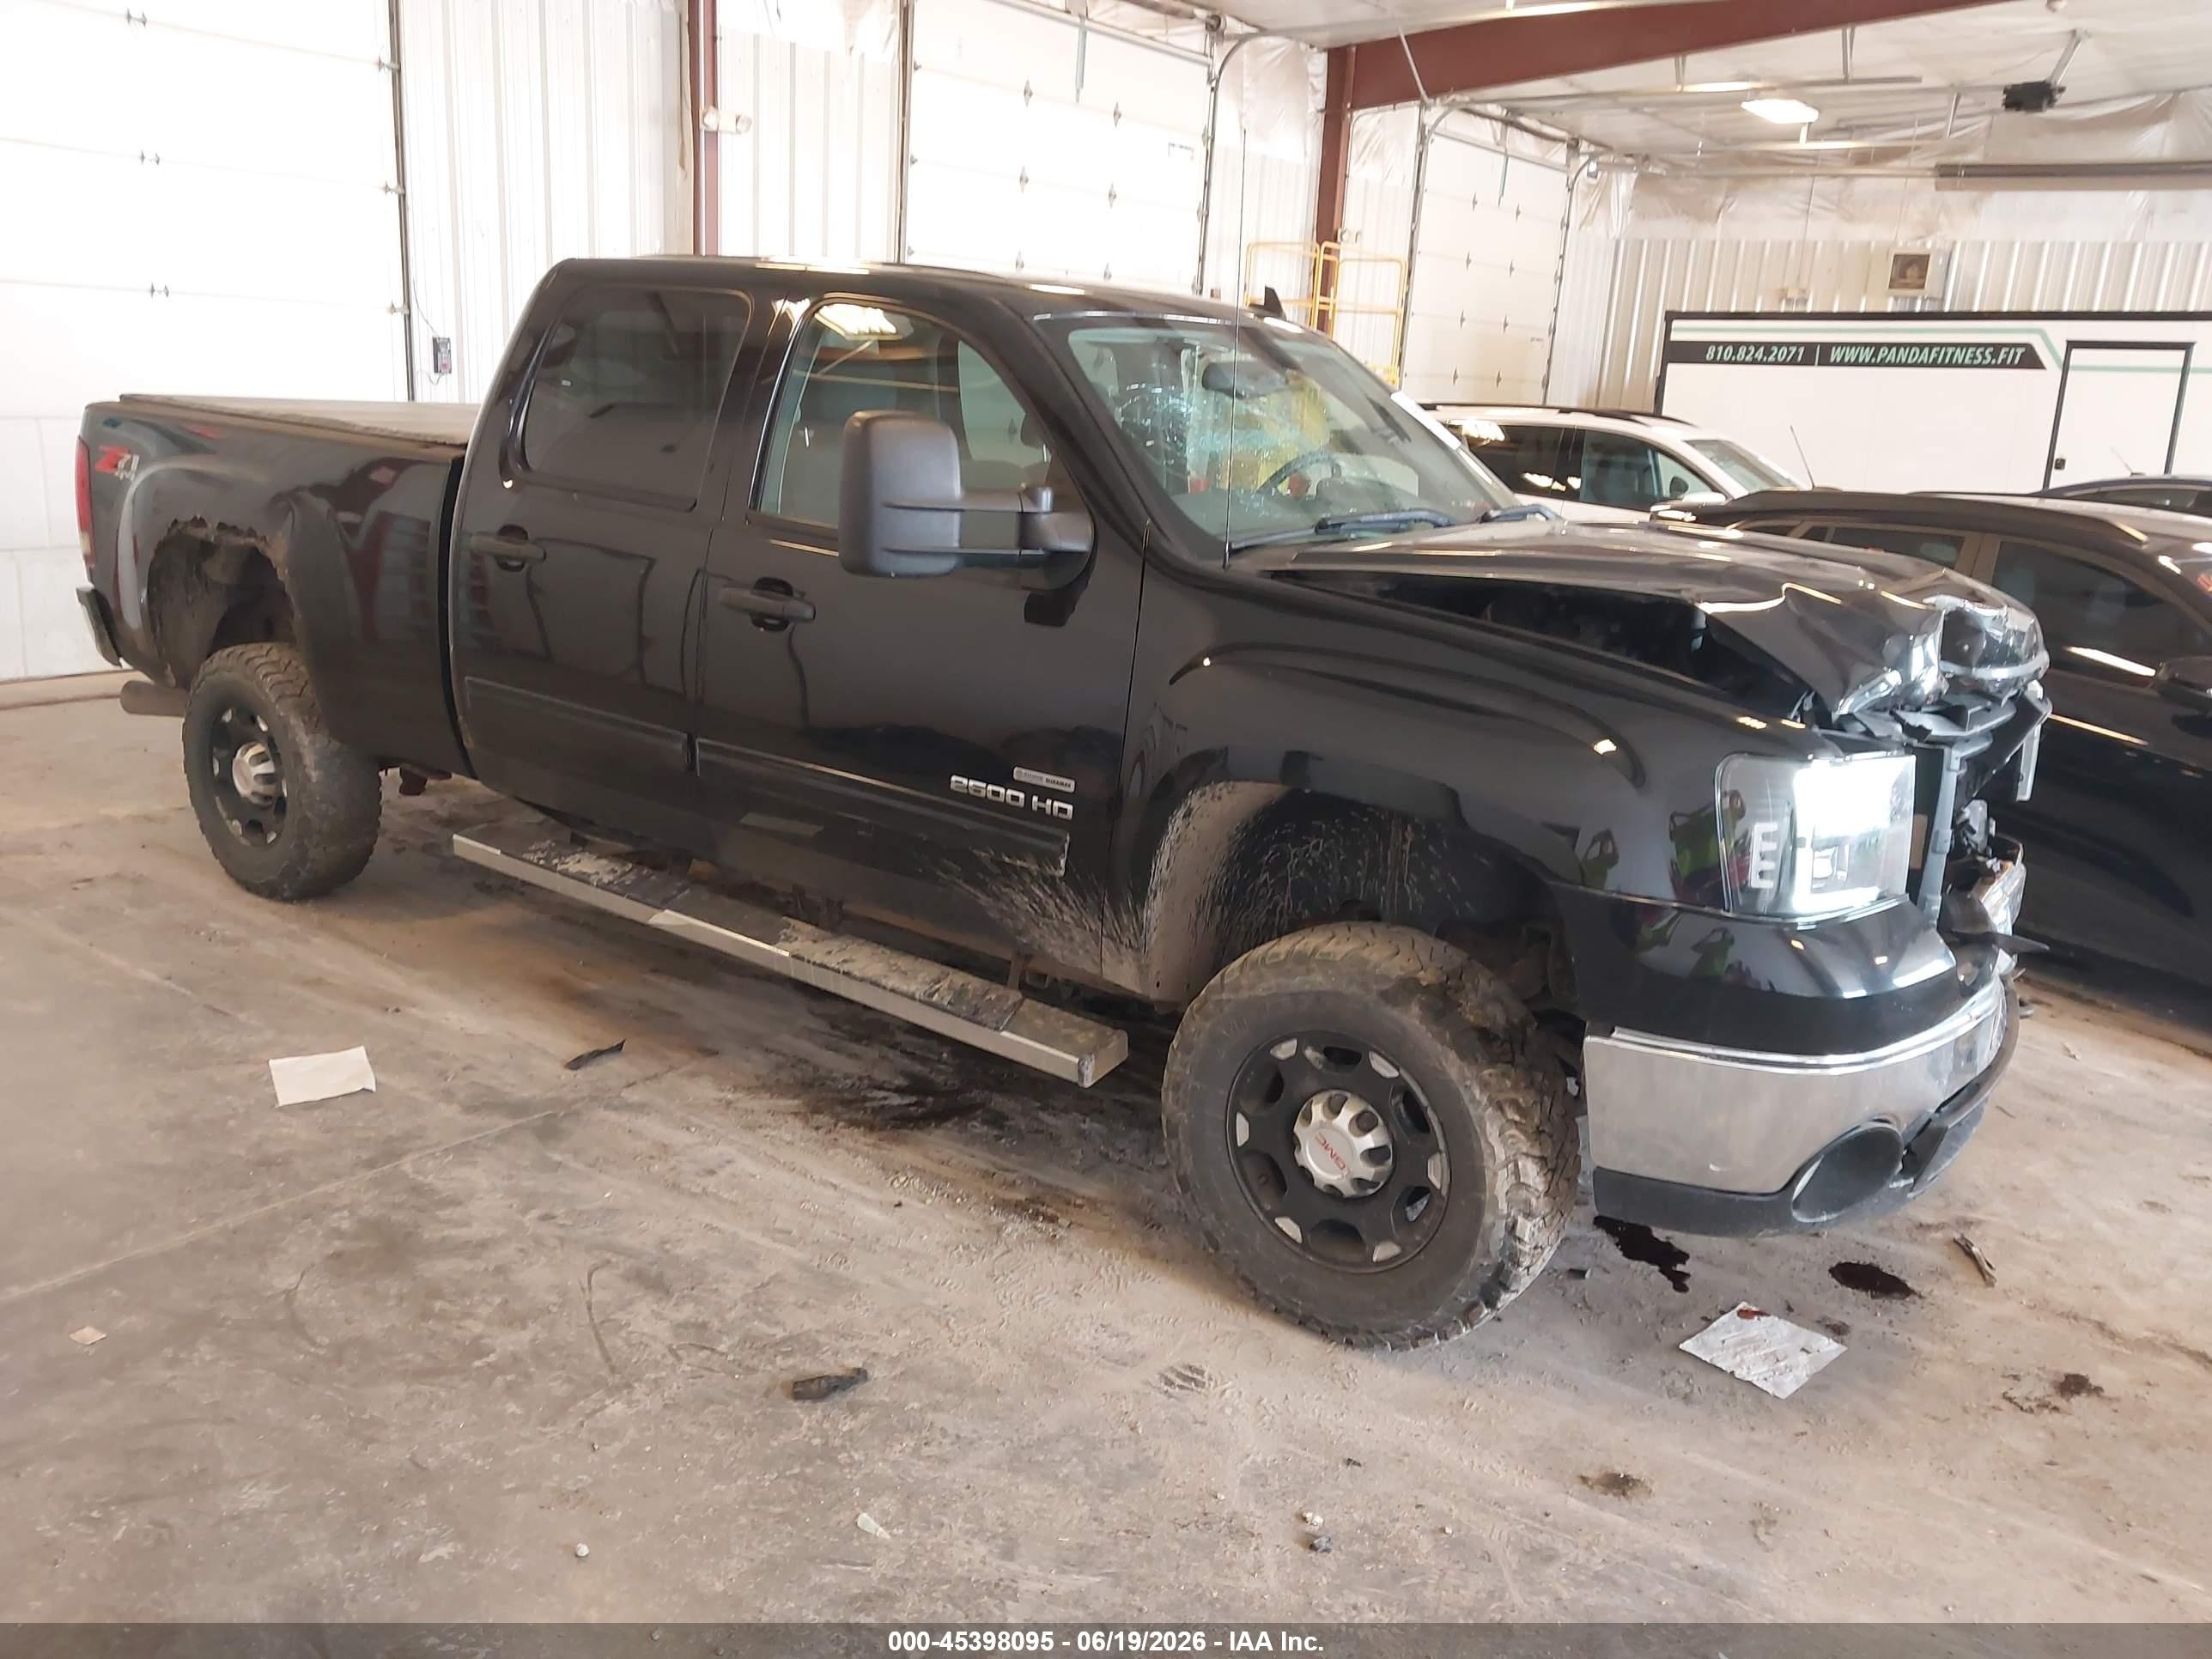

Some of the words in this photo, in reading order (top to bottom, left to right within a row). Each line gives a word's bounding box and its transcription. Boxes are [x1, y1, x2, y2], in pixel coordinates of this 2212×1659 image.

[1705, 344, 1805, 362] 810.824.2071
[1829, 345, 2026, 365] WWW.PANDAFITNESS.FIT
[950, 775, 1025, 808] 2500
[1031, 794, 1074, 821] HD
[1315, 1132, 1347, 1170] GMC
